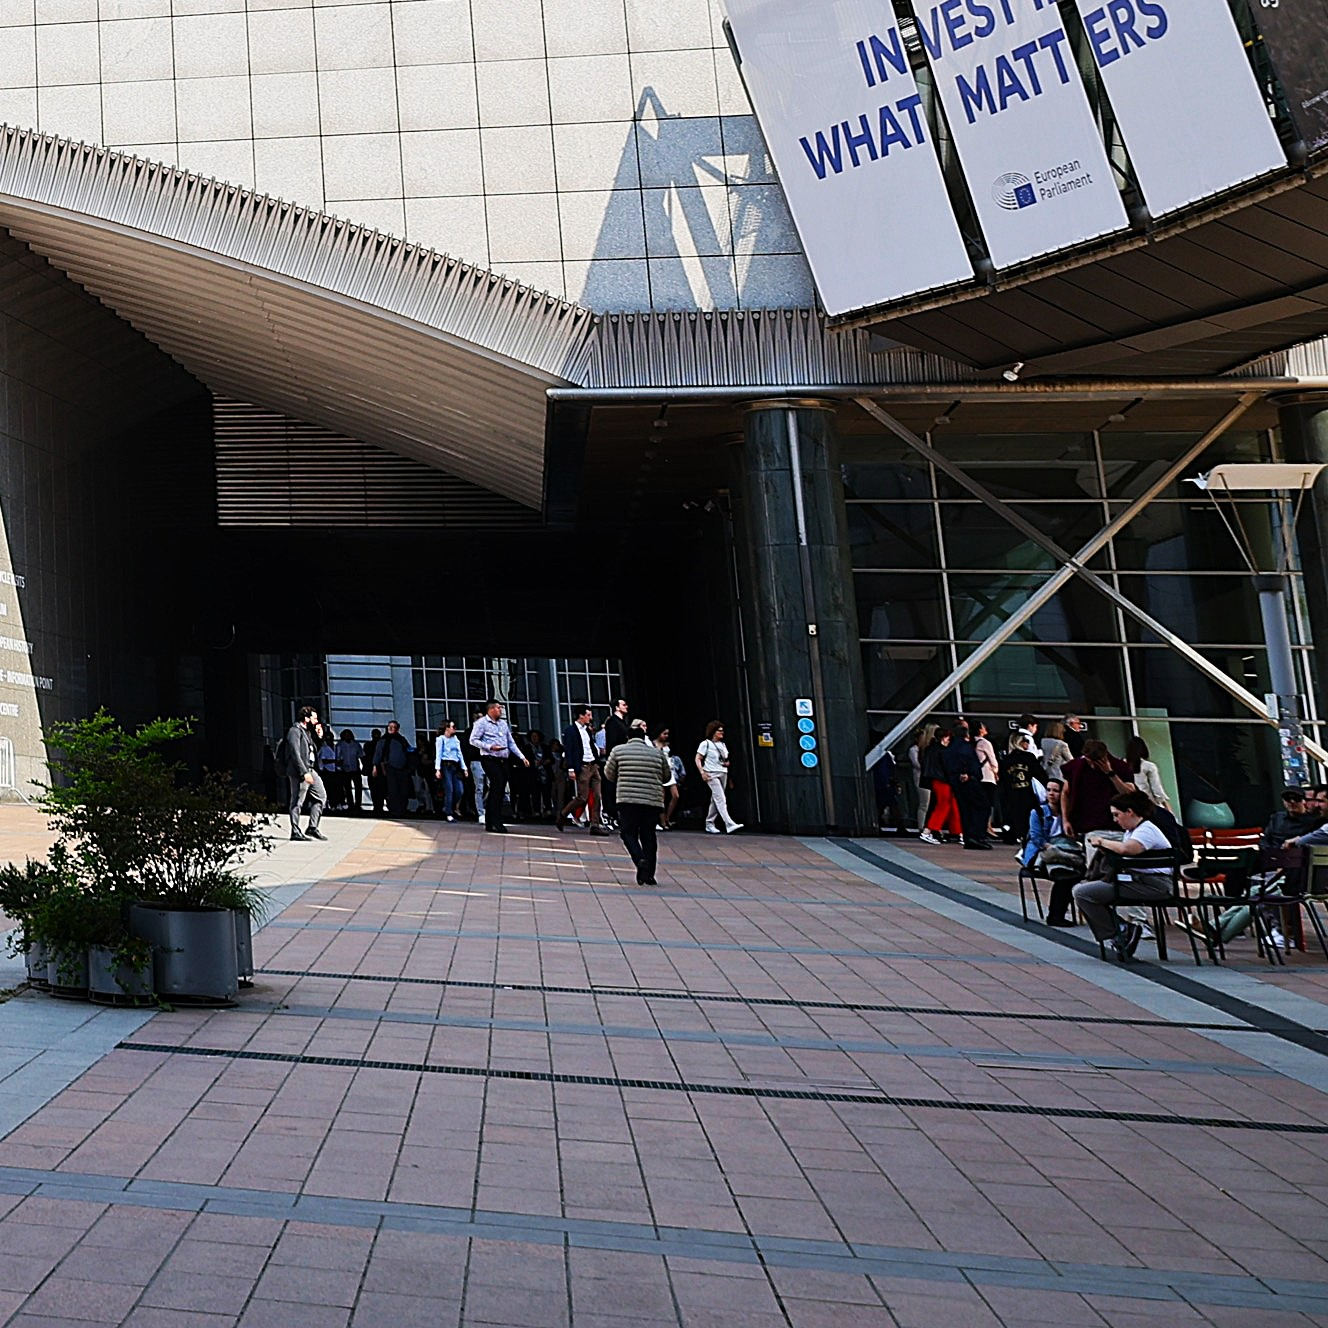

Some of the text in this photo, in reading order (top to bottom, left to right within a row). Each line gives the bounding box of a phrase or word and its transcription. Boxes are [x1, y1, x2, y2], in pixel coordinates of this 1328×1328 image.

[799, 93, 926, 180] WHAT
[1034, 159, 1081, 185] European
[1039, 172, 1093, 201] Parliament
